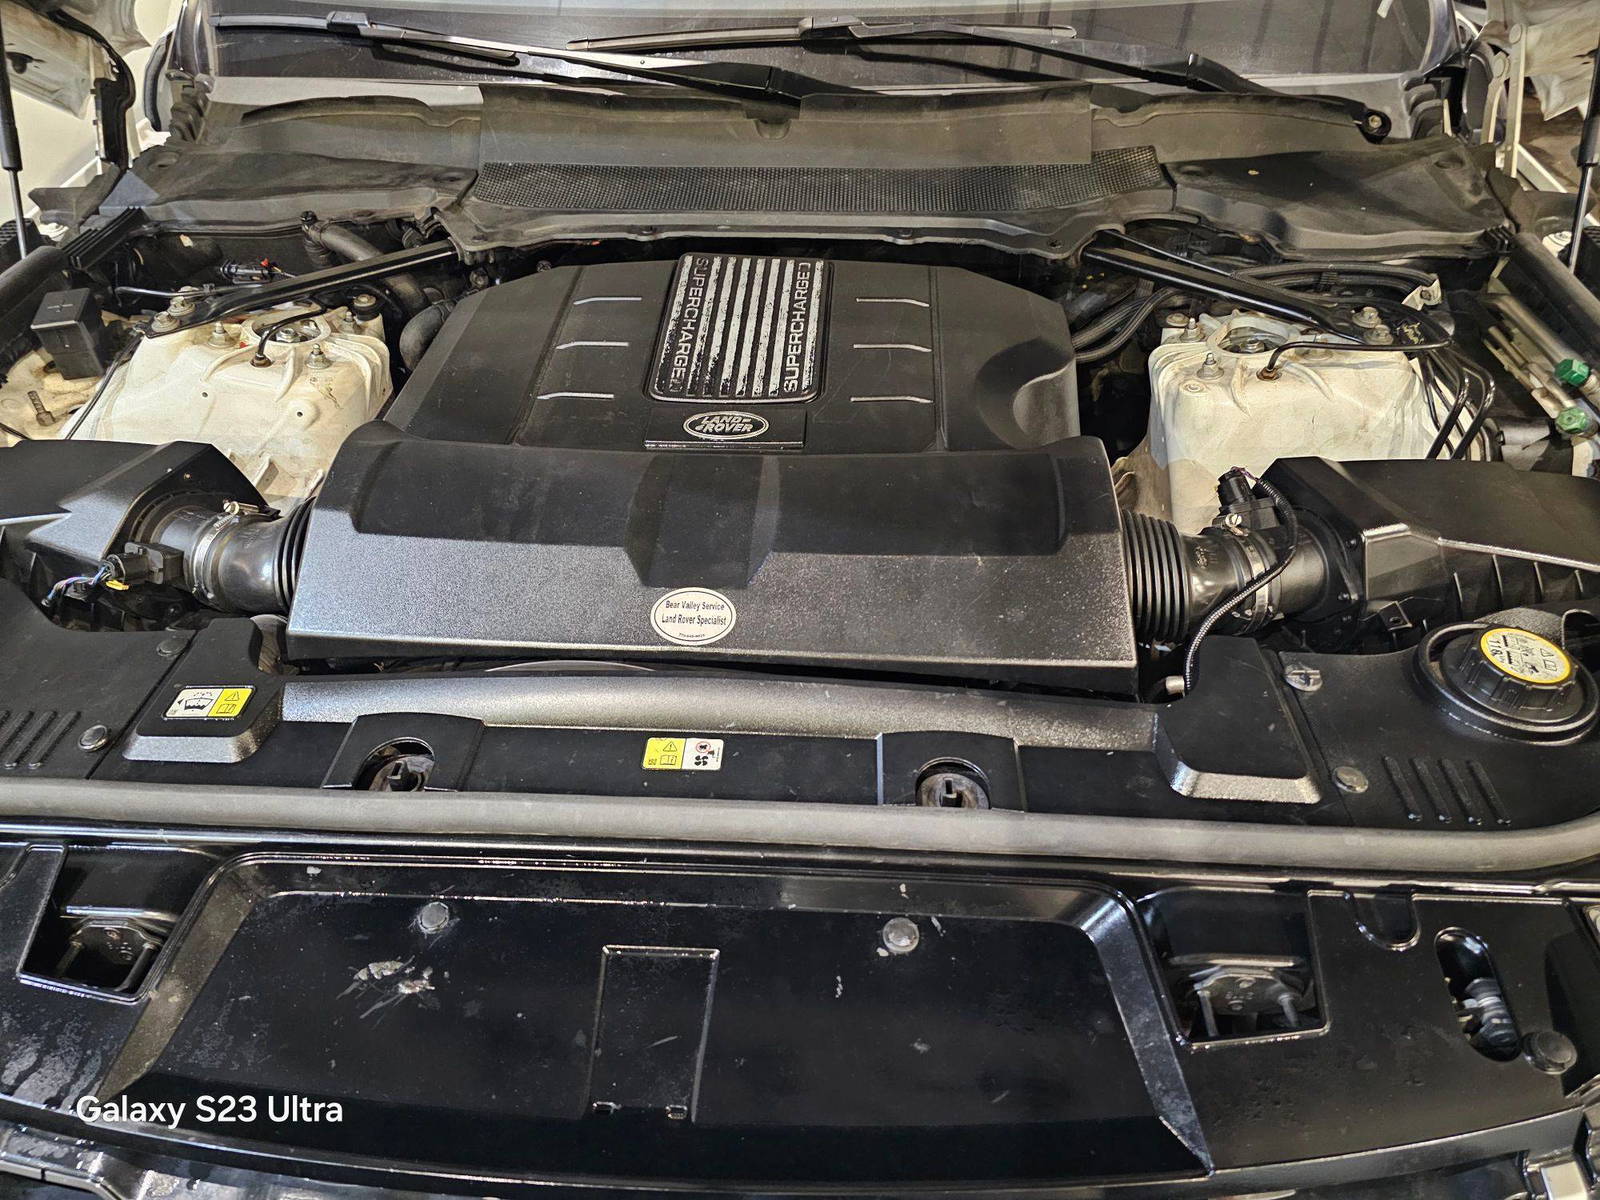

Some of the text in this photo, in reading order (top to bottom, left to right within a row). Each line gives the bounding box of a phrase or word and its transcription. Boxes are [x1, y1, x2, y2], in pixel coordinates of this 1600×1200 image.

[783, 262, 811, 393] SUPERCHARGED
[701, 415, 743, 424] LAND
[702, 423, 754, 433] ROVER
[665, 600, 725, 612] Bear Valley Service
[661, 613, 727, 627] Land Rover Specialist
